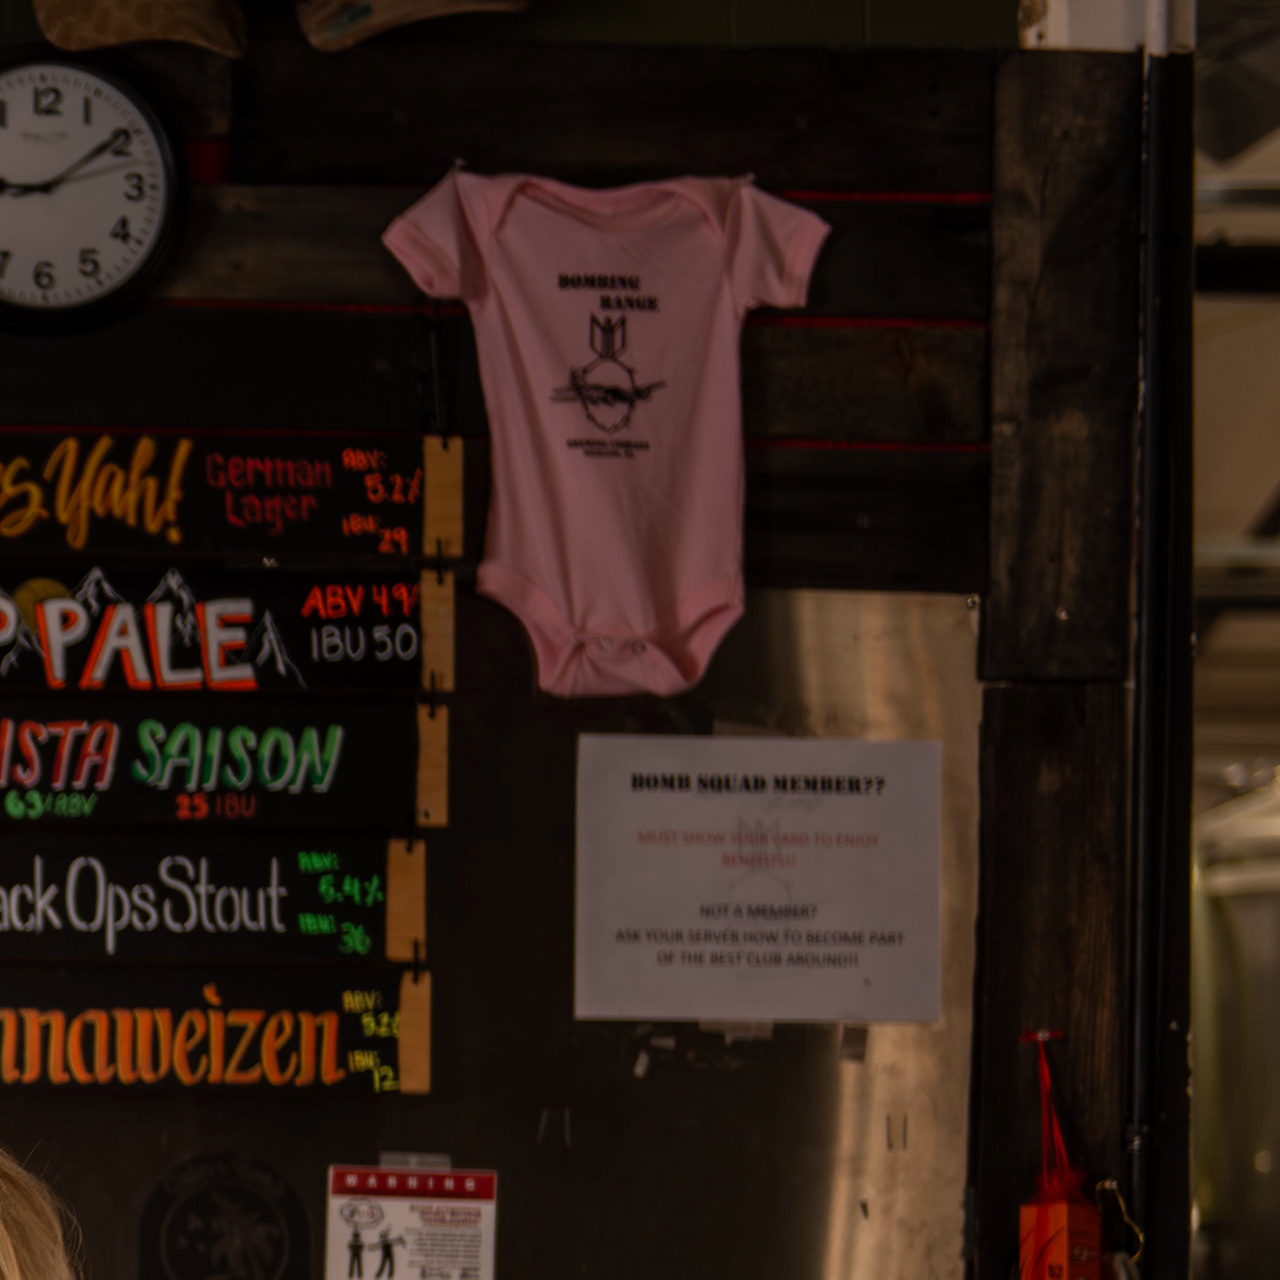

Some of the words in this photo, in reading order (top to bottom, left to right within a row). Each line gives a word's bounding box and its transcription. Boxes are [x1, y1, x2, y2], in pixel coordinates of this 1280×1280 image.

[33, 86, 64, 116] 12
[84, 96, 91, 125] 1
[108, 128, 131, 156] 2
[123, 172, 145, 201] 3
[110, 216, 131, 243] 4
[34, 261, 55, 290] 6
[78, 248, 100, 277] 5
[558, 273, 640, 289] BOMBING
[600, 294, 658, 311] RANGE
[204, 450, 333, 490] German
[42, 436, 192, 550] Yah!
[224, 490, 320, 538] Lager
[377, 525, 410, 556] 29
[300, 582, 366, 620] ABV
[36, 598, 257, 690] PALE
[310, 623, 367, 663] IBU
[371, 622, 419, 662] 50
[132, 720, 342, 792] SAISON
[631, 772, 691, 792] BOMB
[697, 774, 767, 793] SQUAD
[772, 775, 886, 796] MEMBER??
[175, 792, 210, 820] 25
[214, 794, 255, 819] IBU
[68, 857, 156, 953] Ops
[160, 857, 286, 932] Stout
[700, 903, 730, 918] NOT
[735, 904, 744, 918] A
[748, 904, 818, 919] MEMBER?
[616, 928, 642, 943] ASK
[645, 928, 684, 943] YOUR
[688, 929, 739, 944] SERVER
[743, 930, 779, 945] HOW
[783, 931, 803, 945] TO
[806, 931, 866, 946] BECOME
[869, 932, 905, 947] PART
[657, 951, 675, 965] OF
[680, 951, 706, 966] THE
[710, 951, 742, 967] BEST
[747, 952, 782, 967] CLUB
[786, 953, 859, 968] AROUND!!
[344, 1173, 476, 1193] WARNING
